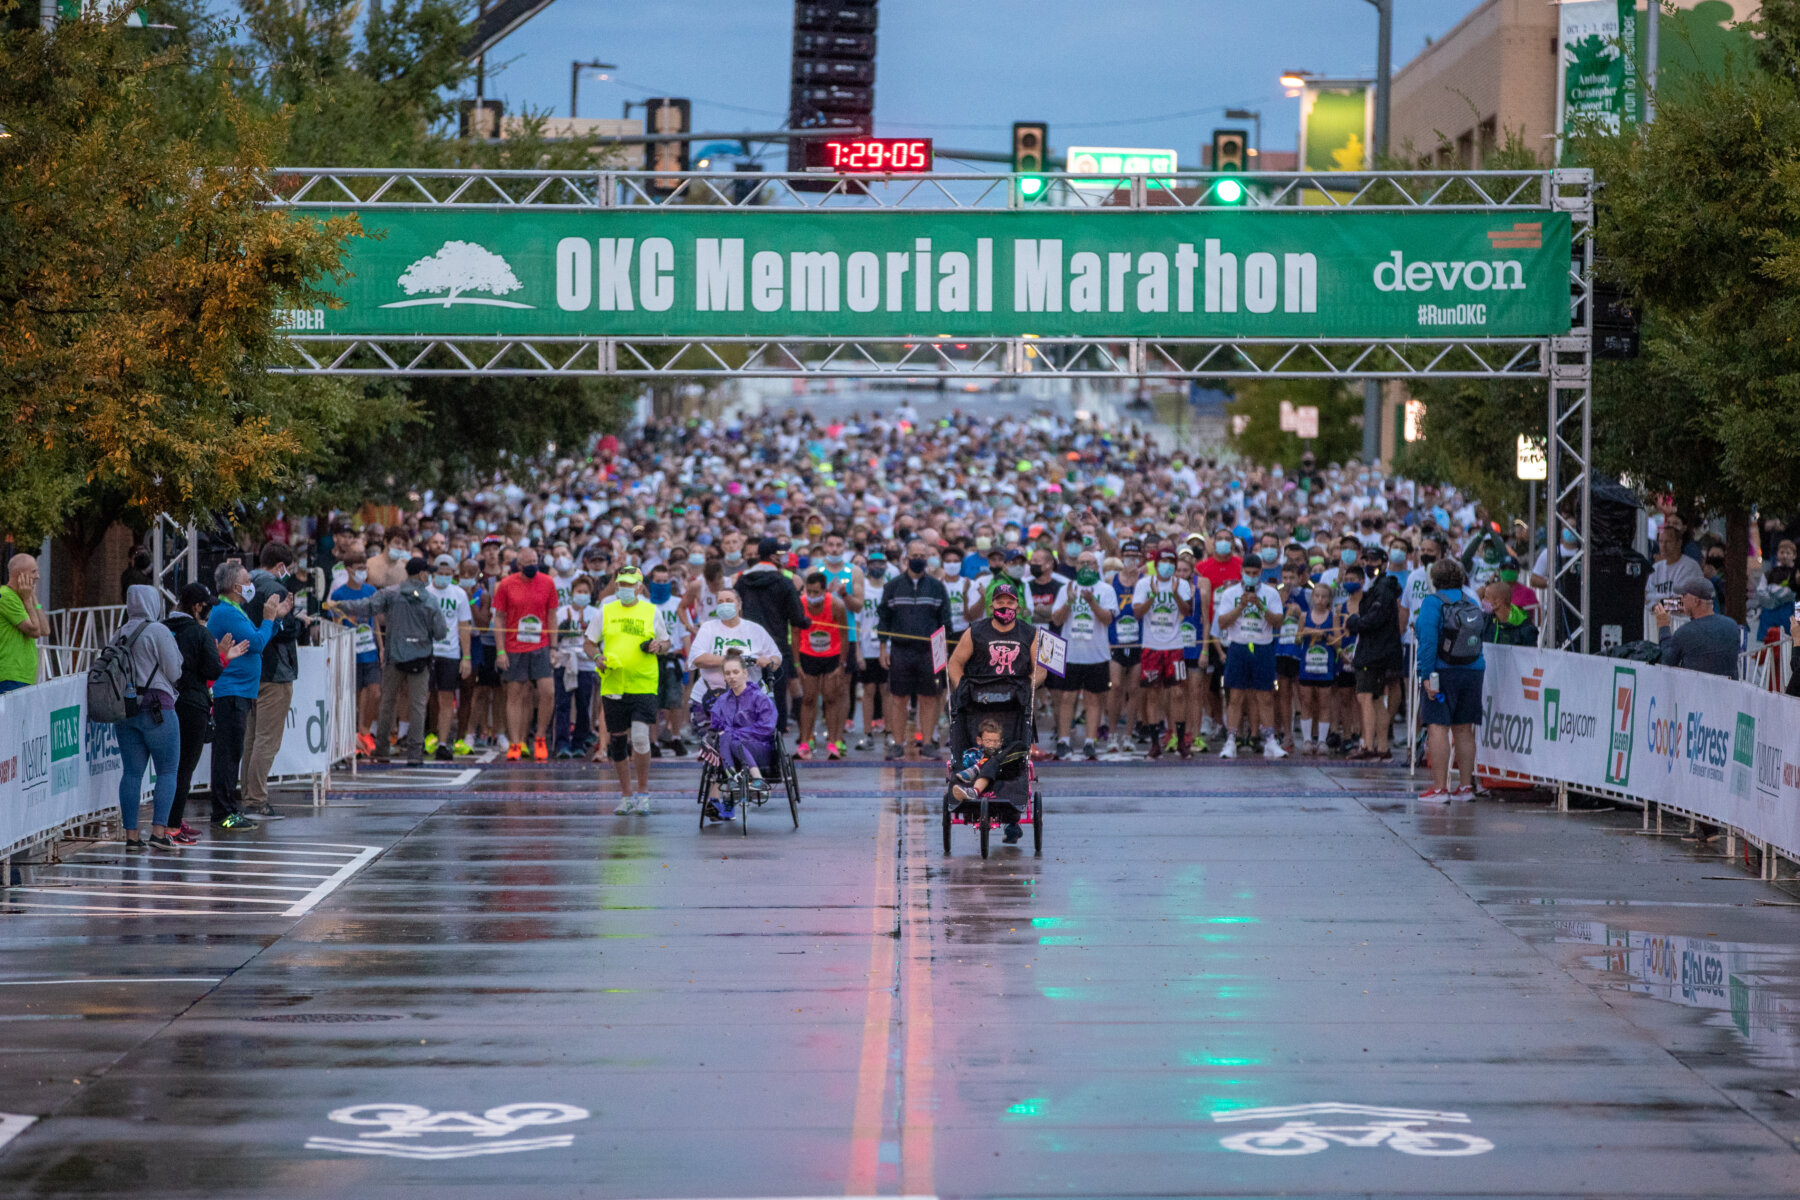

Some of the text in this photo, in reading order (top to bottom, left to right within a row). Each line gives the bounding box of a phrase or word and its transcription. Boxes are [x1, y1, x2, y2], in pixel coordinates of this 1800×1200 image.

[1571, 86, 1618, 100] Christopher
[1579, 73, 1610, 86] Anthony
[1624, 93, 1636, 113] run
[556, 237, 1317, 314] OKC Memorial Marathon
[1373, 250, 1527, 292] devon
[1417, 303, 1487, 326] #RunOKC
[1173, 660, 1187, 681] 10
[1616, 686, 1632, 732] 7
[1481, 695, 1534, 756] devon
[1559, 711, 1597, 744] paycom
[1647, 695, 1683, 774] Google
[1613, 731, 1630, 753] ELEVEN
